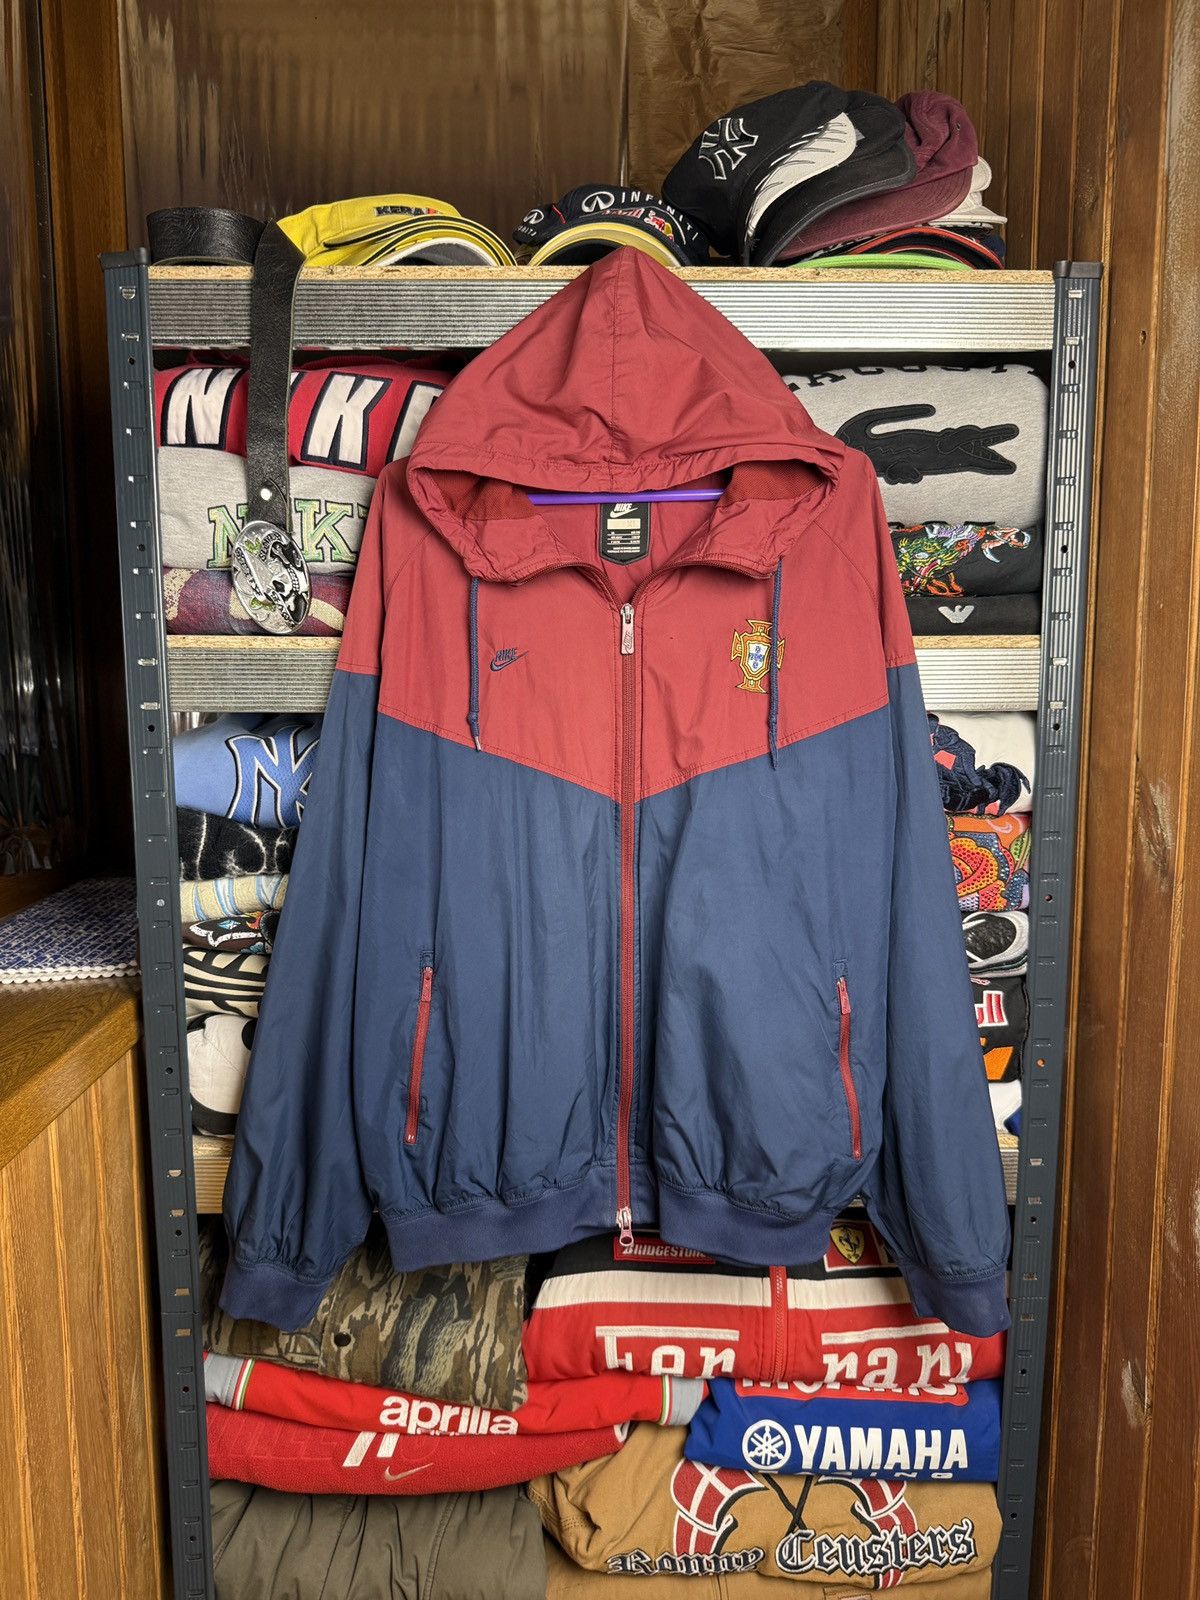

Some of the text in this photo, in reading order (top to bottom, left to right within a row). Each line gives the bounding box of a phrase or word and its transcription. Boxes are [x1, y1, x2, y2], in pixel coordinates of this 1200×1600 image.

[698, 117, 759, 180] NY
[621, 190, 699, 241] INFINITI
[161, 367, 447, 470] NK
[206, 497, 368, 569] NK
[613, 502, 634, 512] NIKE
[495, 647, 517, 662] NIKE
[794, 1424, 969, 1471] YAMAHA
[606, 1516, 978, 1577] Ronny Ceusters
